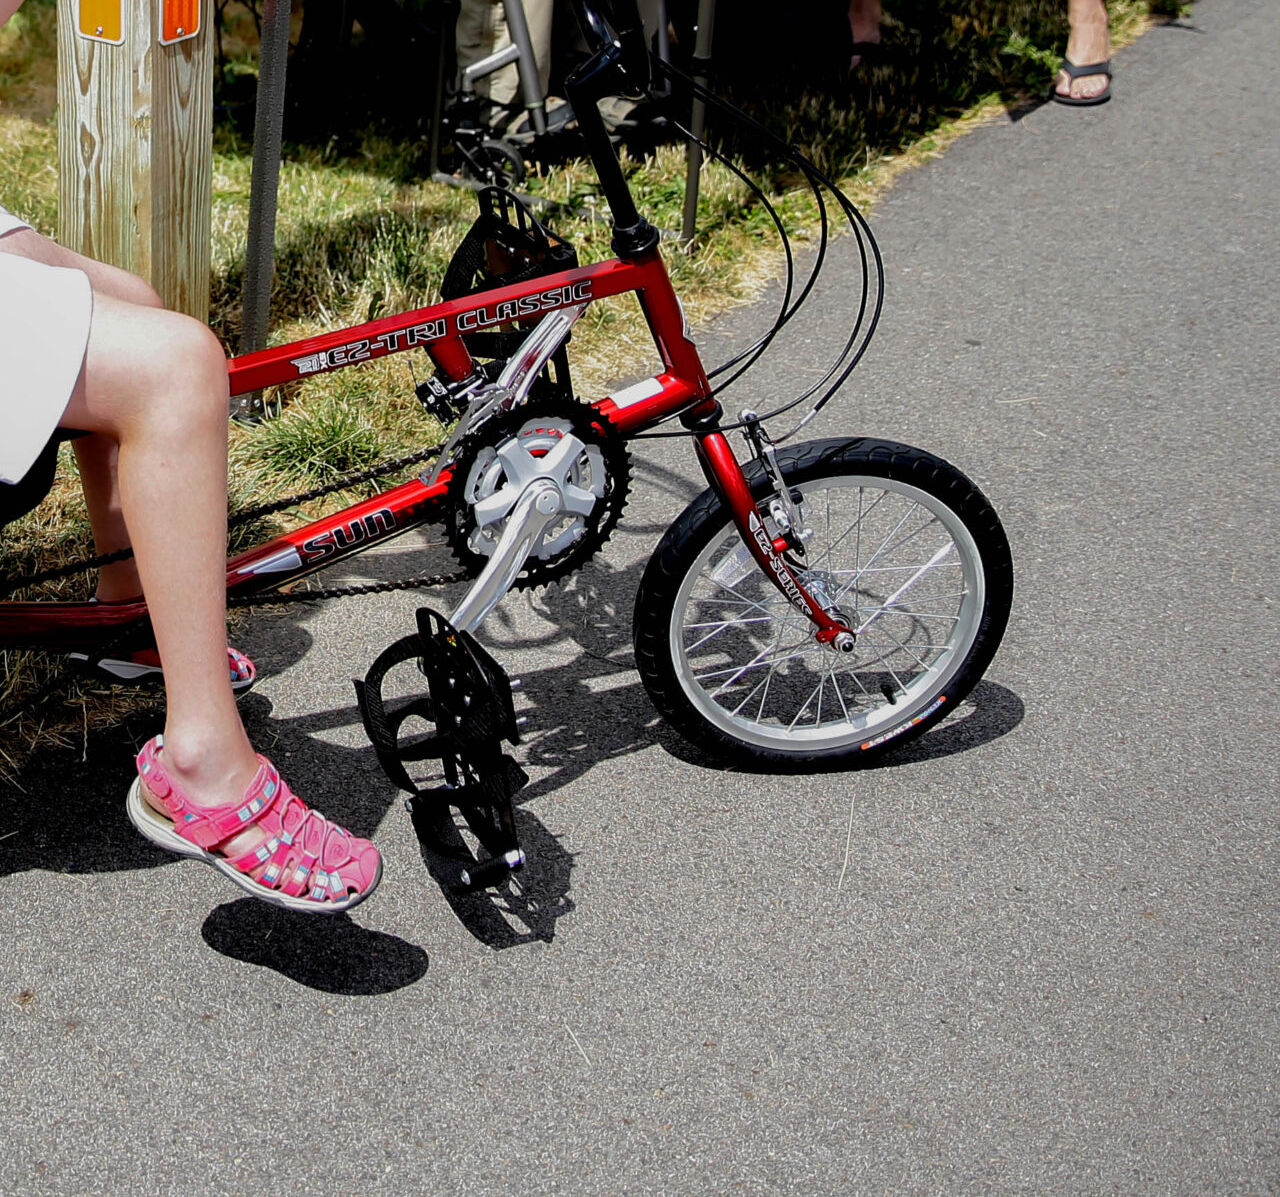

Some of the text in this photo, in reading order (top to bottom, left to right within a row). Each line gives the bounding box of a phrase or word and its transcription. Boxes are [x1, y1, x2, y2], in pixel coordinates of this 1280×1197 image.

[328, 319, 447, 367] EZ-TRI
[457, 281, 592, 332] CLASSIC
[754, 528, 812, 615] EZ-SERIES
